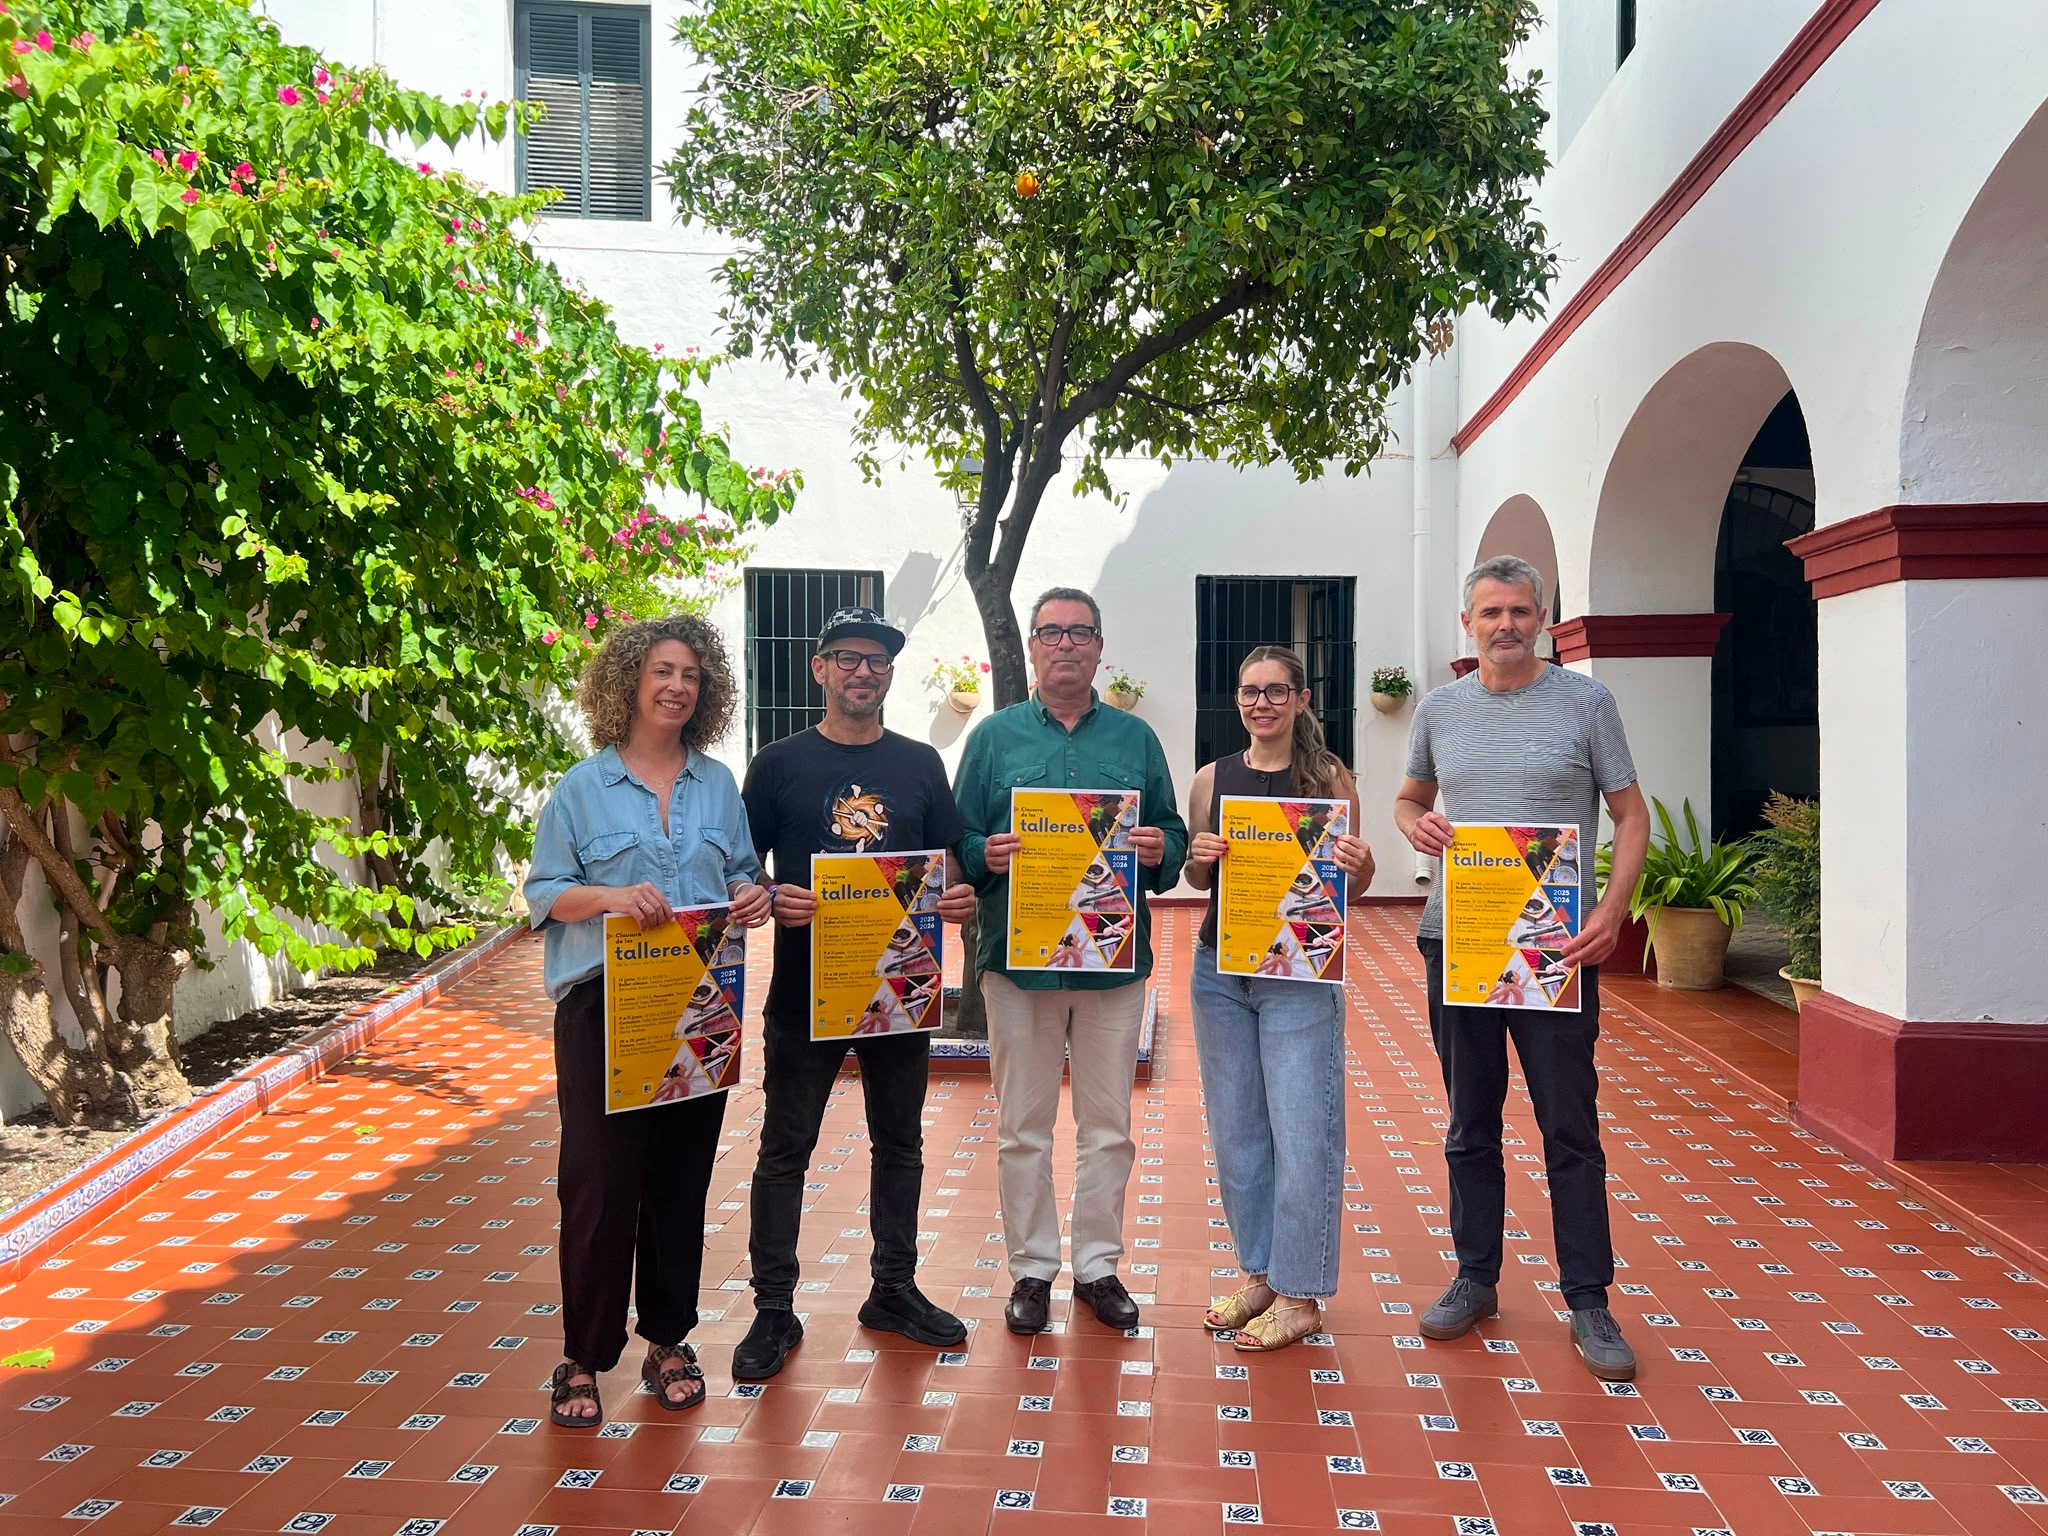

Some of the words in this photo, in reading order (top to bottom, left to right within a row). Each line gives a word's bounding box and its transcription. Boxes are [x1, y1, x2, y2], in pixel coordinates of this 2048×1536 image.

[1021, 817, 1084, 833] talleres
[1228, 825, 1292, 842] talleres
[1453, 851, 1521, 867] talleres
[821, 884, 889, 900] talleres
[615, 942, 690, 960] talleres
[720, 970, 736, 978] 2025
[720, 977, 736, 985] 2026
